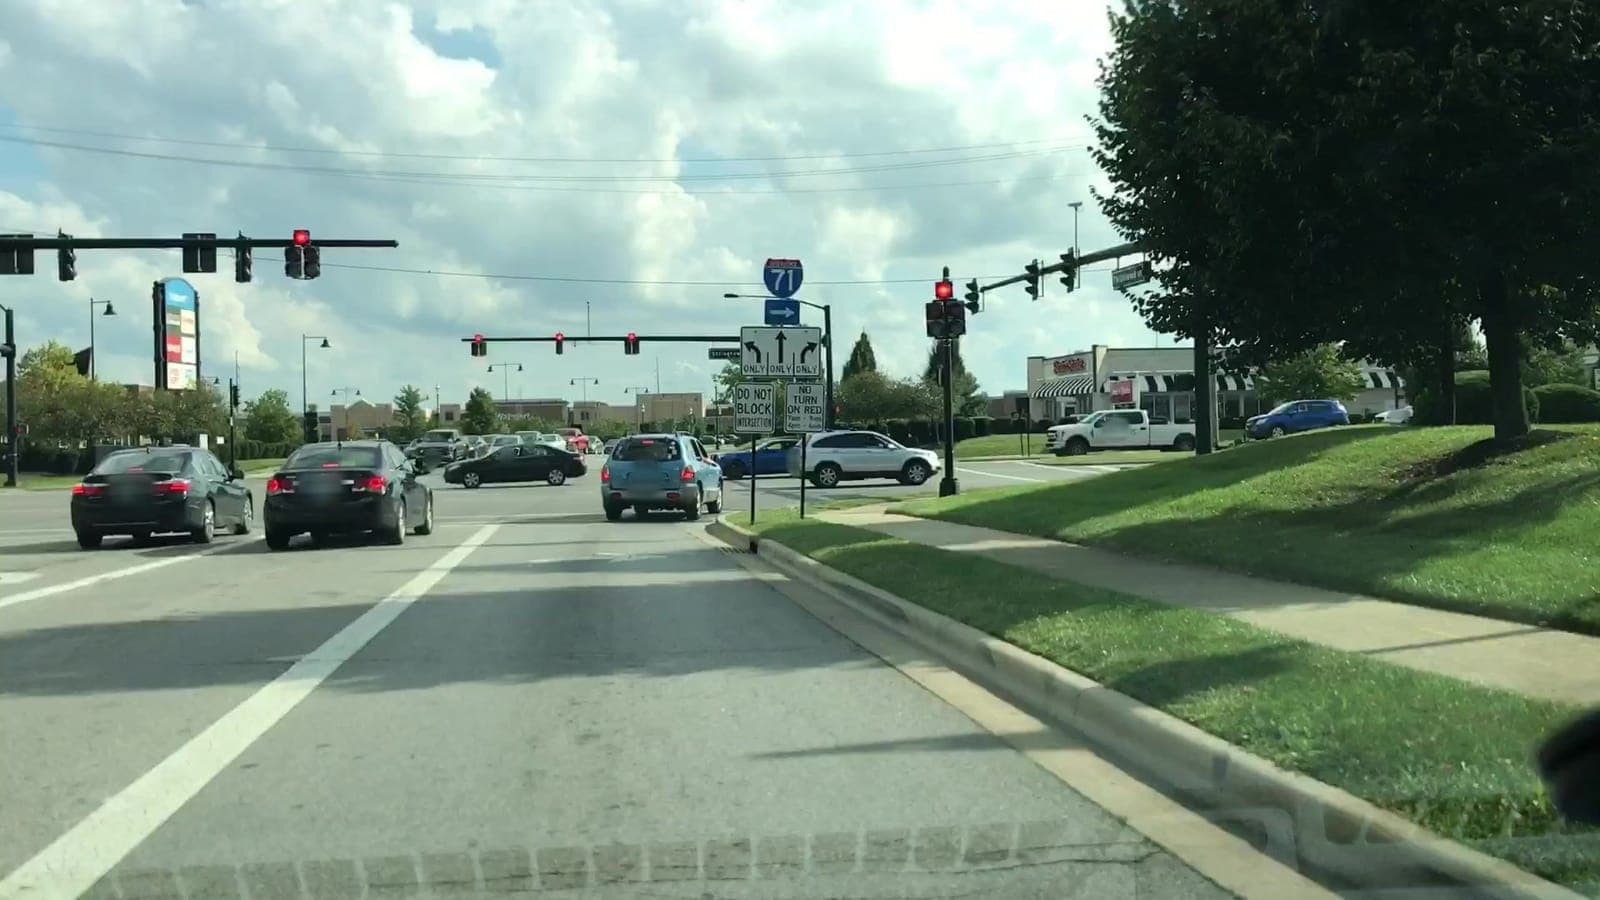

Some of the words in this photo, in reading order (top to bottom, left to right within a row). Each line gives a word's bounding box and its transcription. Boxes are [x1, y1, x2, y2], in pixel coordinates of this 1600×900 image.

[770, 268, 794, 291] 71
[743, 365, 765, 373] ONLY
[770, 365, 792, 373] ONLY
[795, 365, 817, 373] ONLY
[737, 388, 750, 400] DO
[754, 388, 772, 400] NOT
[799, 386, 812, 394] NO
[794, 396, 817, 404] TURN
[737, 403, 772, 415] BLOCK
[787, 404, 801, 414] ON
[803, 405, 822, 414] RED
